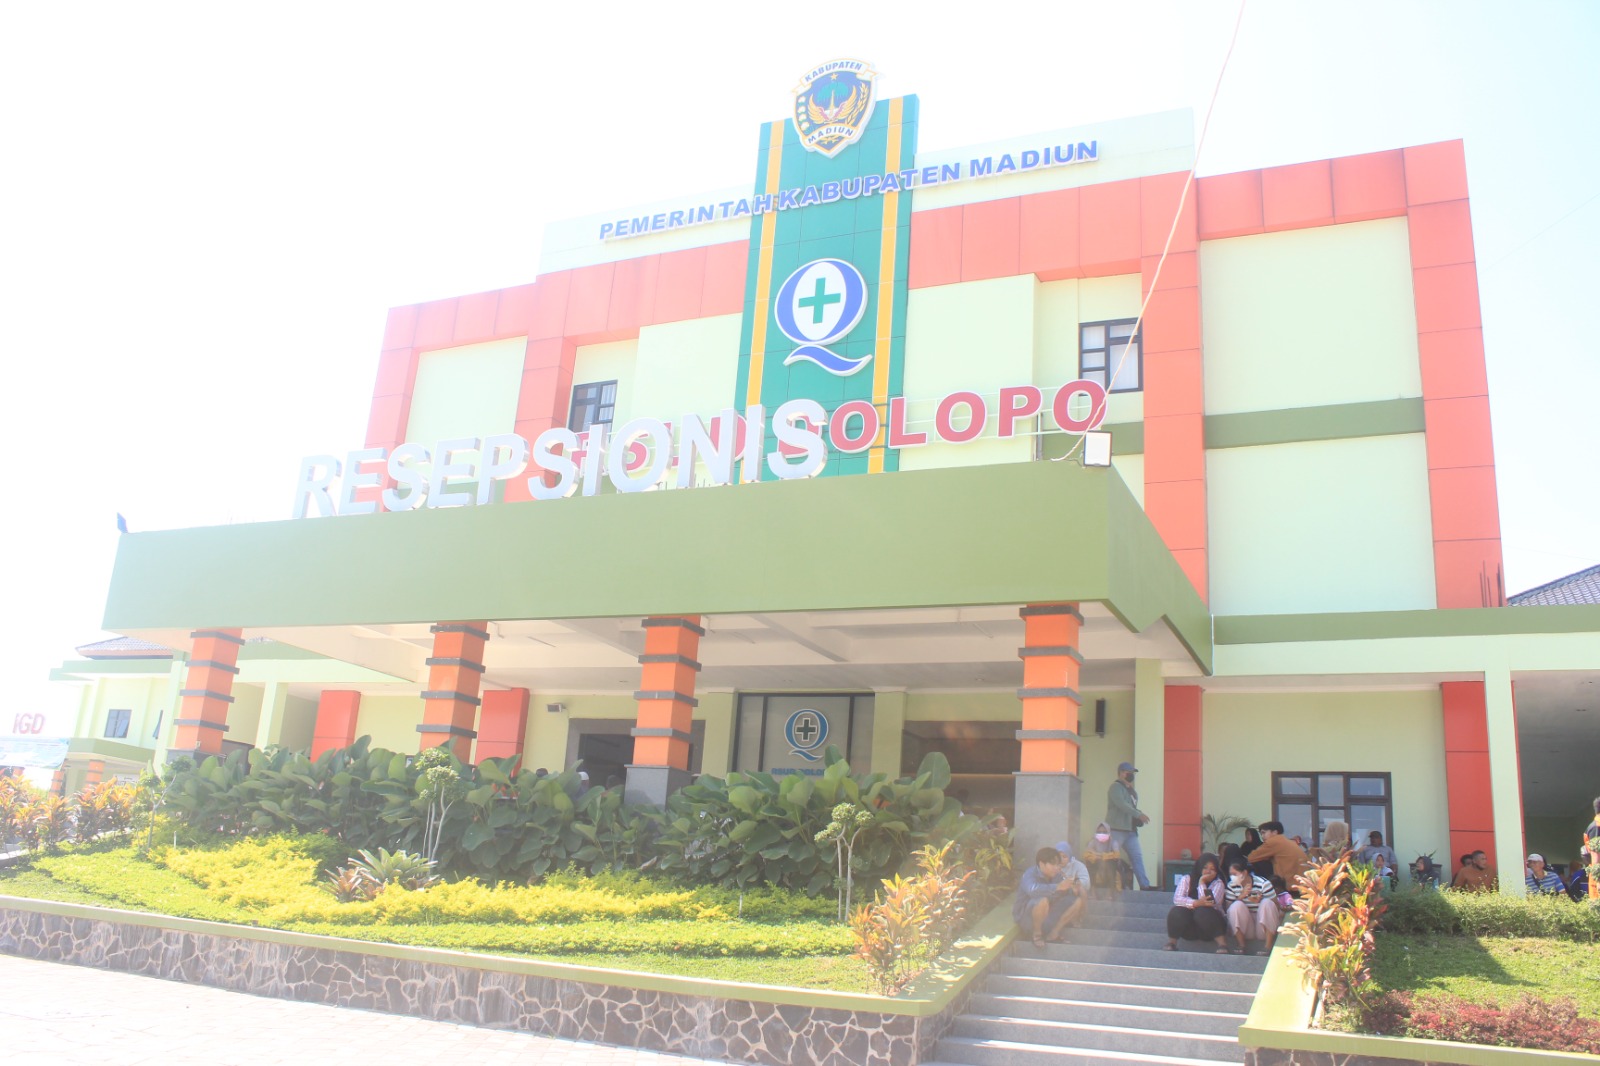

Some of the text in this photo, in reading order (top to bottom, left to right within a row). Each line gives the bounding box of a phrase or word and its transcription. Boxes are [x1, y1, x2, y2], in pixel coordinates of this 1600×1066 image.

[804, 61, 863, 82] KABUPATEN
[807, 126, 854, 144] MADIUN
[599, 140, 1099, 241] PEMERINTAH KABUPATEN MADIUN
[291, 398, 829, 519] RESEPSIONIS
[12, 712, 47, 735] IGD
